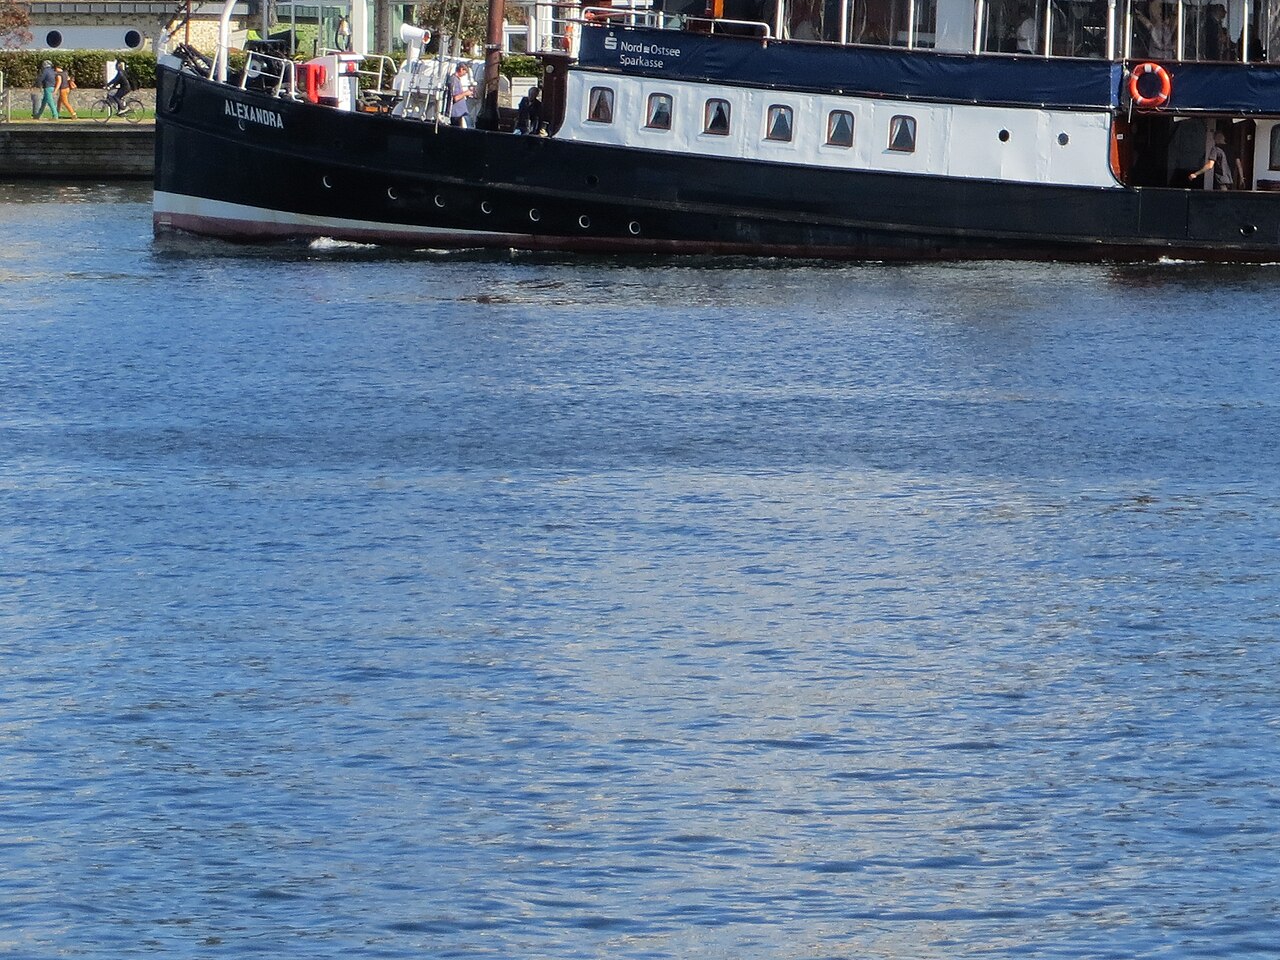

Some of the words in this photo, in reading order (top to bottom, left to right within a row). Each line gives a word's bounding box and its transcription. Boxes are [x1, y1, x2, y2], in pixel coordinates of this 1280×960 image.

[620, 41, 643, 53] Nord
[650, 44, 681, 57] Ostsee
[619, 54, 664, 69] Sparkasse
[224, 99, 284, 129] ALEXANDRA
